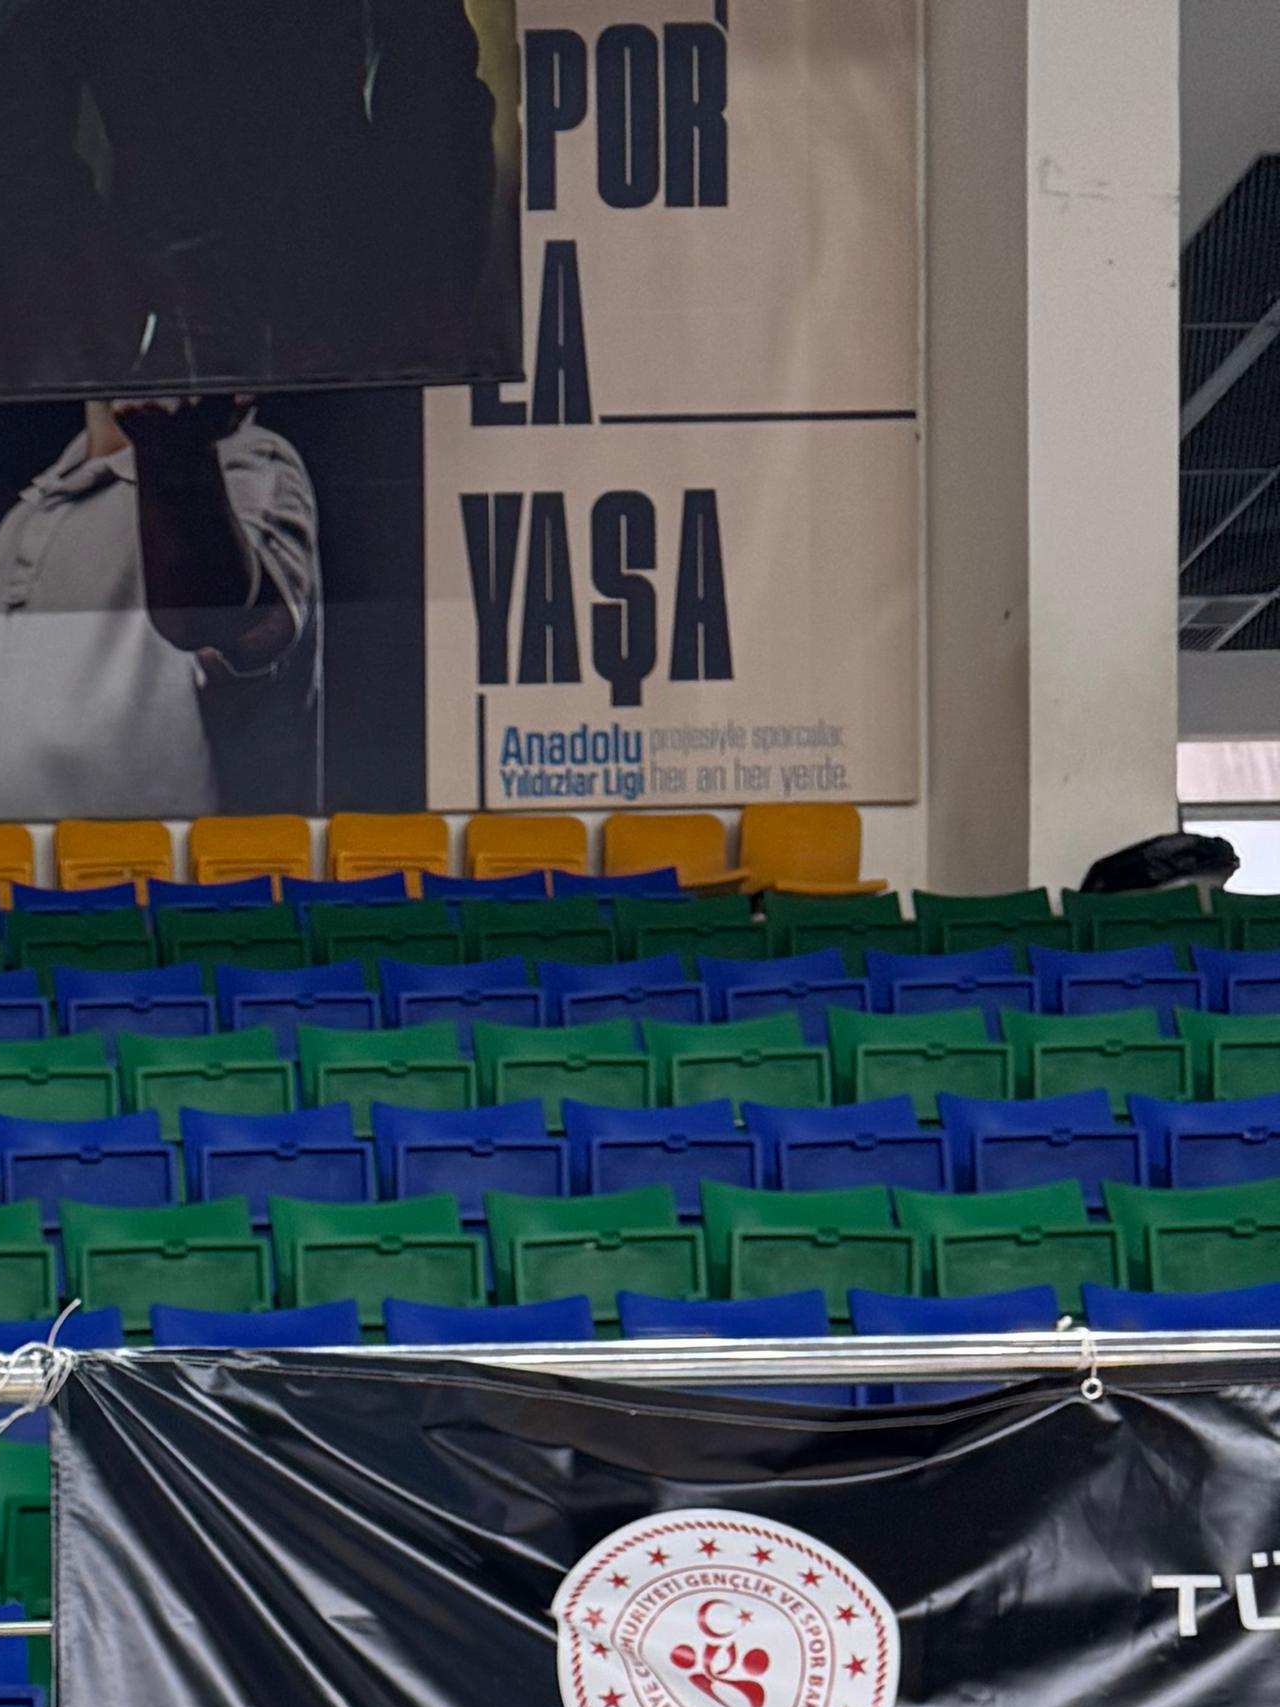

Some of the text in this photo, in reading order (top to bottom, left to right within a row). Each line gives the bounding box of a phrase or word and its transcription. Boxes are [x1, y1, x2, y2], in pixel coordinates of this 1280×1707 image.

[524, 22, 729, 212] POR
[470, 240, 594, 427] A
[458, 488, 735, 707] YAŞA
[500, 722, 644, 767] Anadolu
[602, 766, 645, 801] Ligi
[649, 761, 688, 795] her
[696, 765, 726, 794] an
[733, 758, 771, 792] her
[684, 1572, 781, 1598] GENÇLİK
[780, 1591, 804, 1613] VE
[800, 1613, 827, 1669] SPOR
